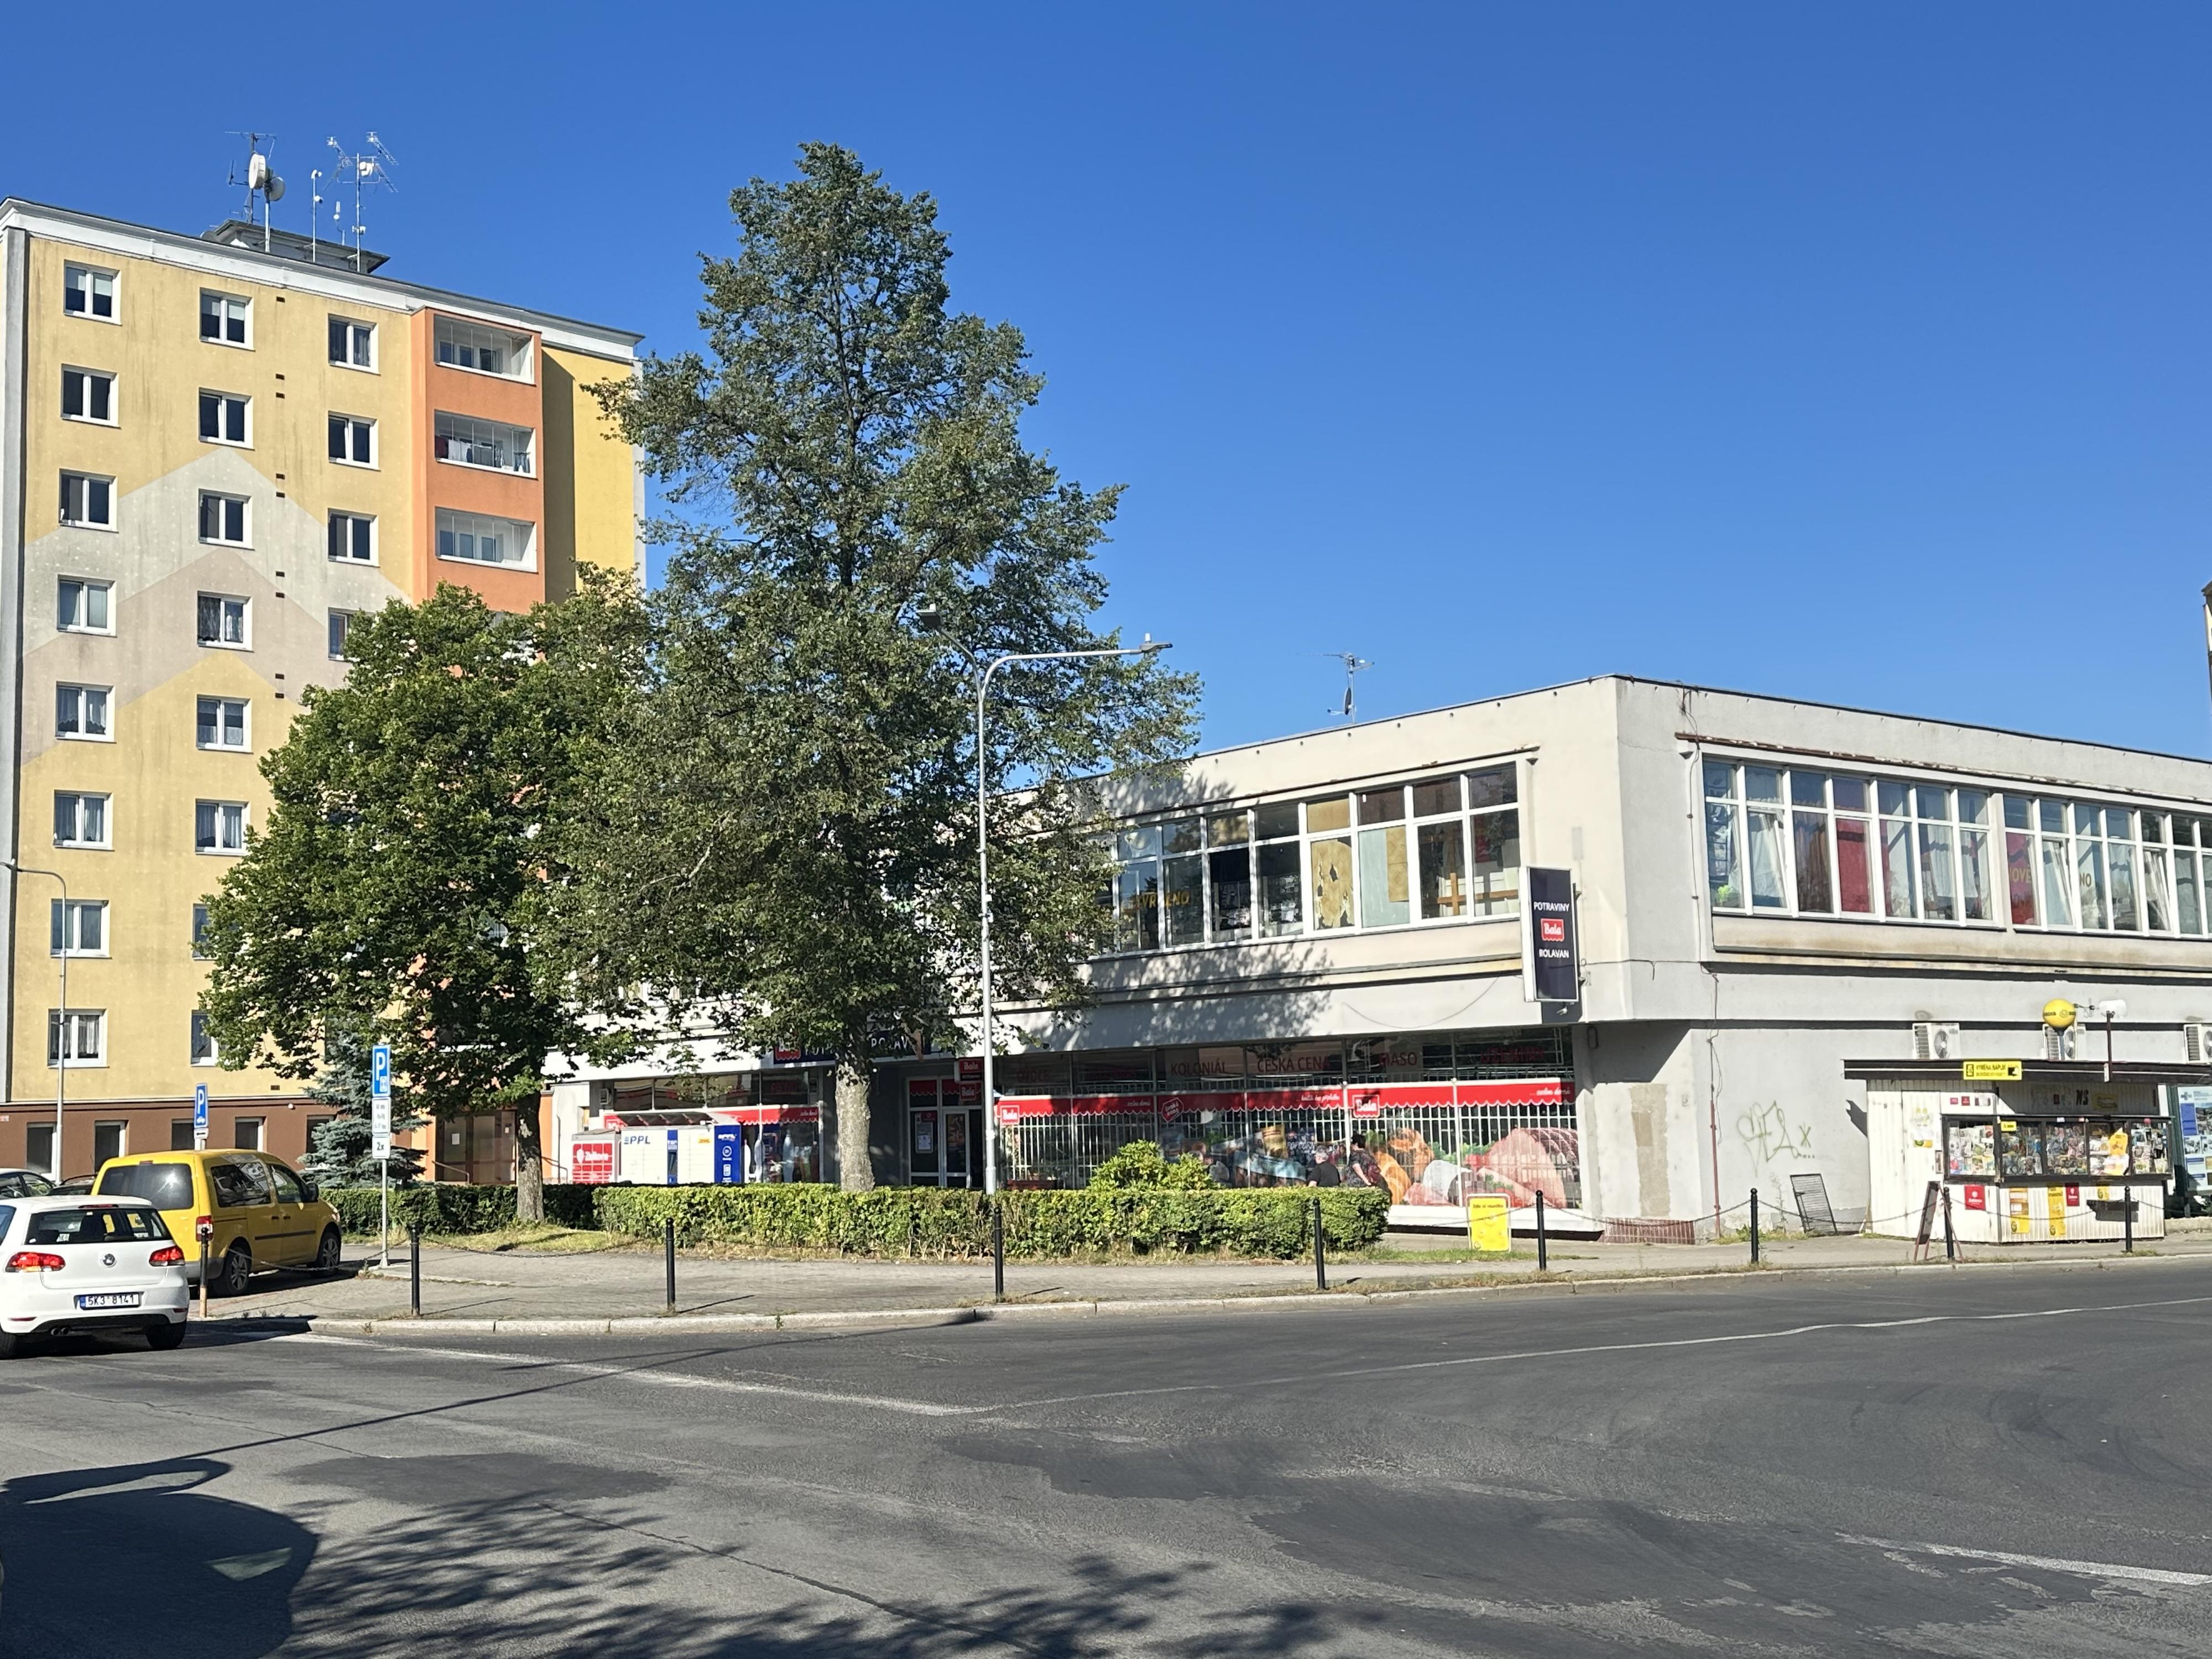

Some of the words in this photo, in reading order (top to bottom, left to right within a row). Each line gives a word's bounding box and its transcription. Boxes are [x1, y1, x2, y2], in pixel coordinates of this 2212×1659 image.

[1533, 901, 1569, 911] POTRAVINY
[1539, 949, 1569, 958] ROLAVAN
[375, 1052, 386, 1081] P
[1171, 1057, 1225, 1076] KOLONIÁL
[1257, 1056, 1295, 1072] ČESKÁ
[1297, 1056, 1331, 1070] CENA
[1379, 1052, 1417, 1067] MASO
[197, 1089, 205, 1114] P
[377, 1142, 384, 1150] 2x
[630, 1136, 650, 1144] PPL
